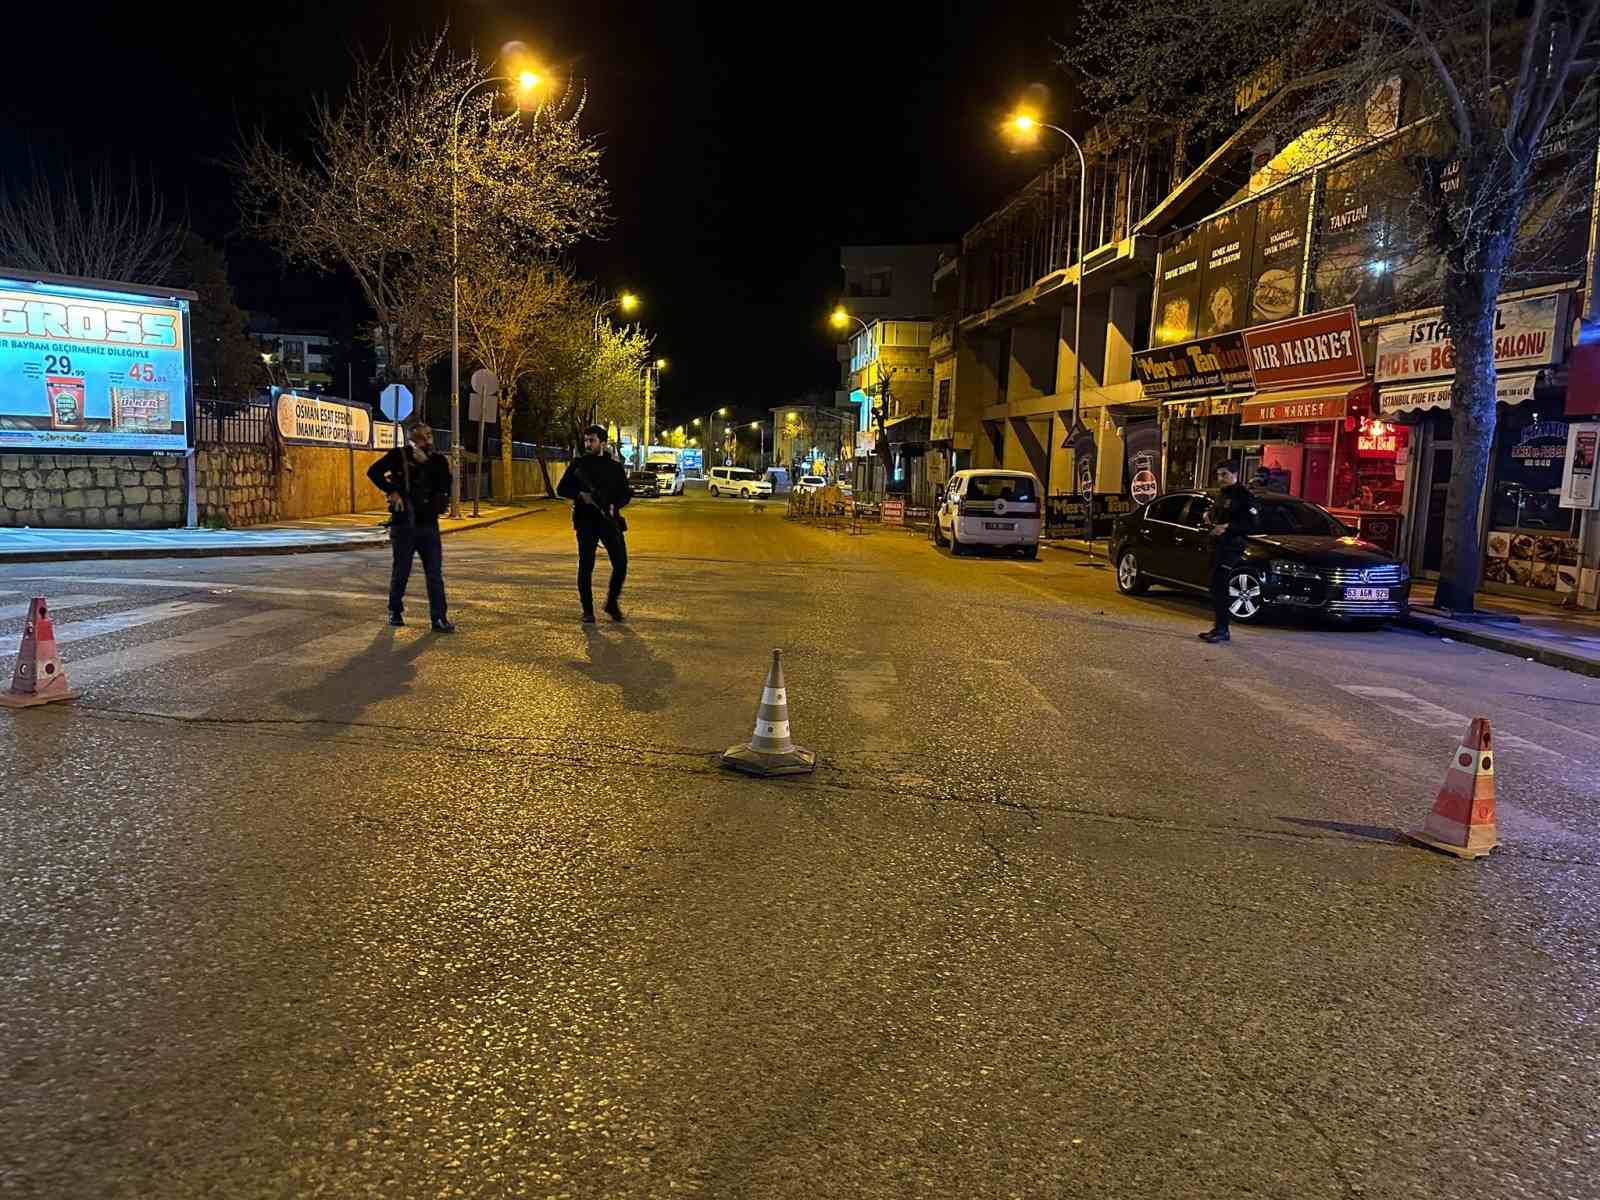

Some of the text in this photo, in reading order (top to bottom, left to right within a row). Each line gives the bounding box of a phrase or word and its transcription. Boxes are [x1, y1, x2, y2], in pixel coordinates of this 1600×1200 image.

[11, 340, 49, 351] BAYRAM
[1252, 329, 1353, 370] MİR MARKET
[1494, 330, 1546, 359] SALONU
[1382, 392, 1410, 408] İSTANBUL
[295, 405, 319, 421] OSMAN
[320, 408, 334, 422] ESAT
[1284, 402, 1325, 417] MARKET
